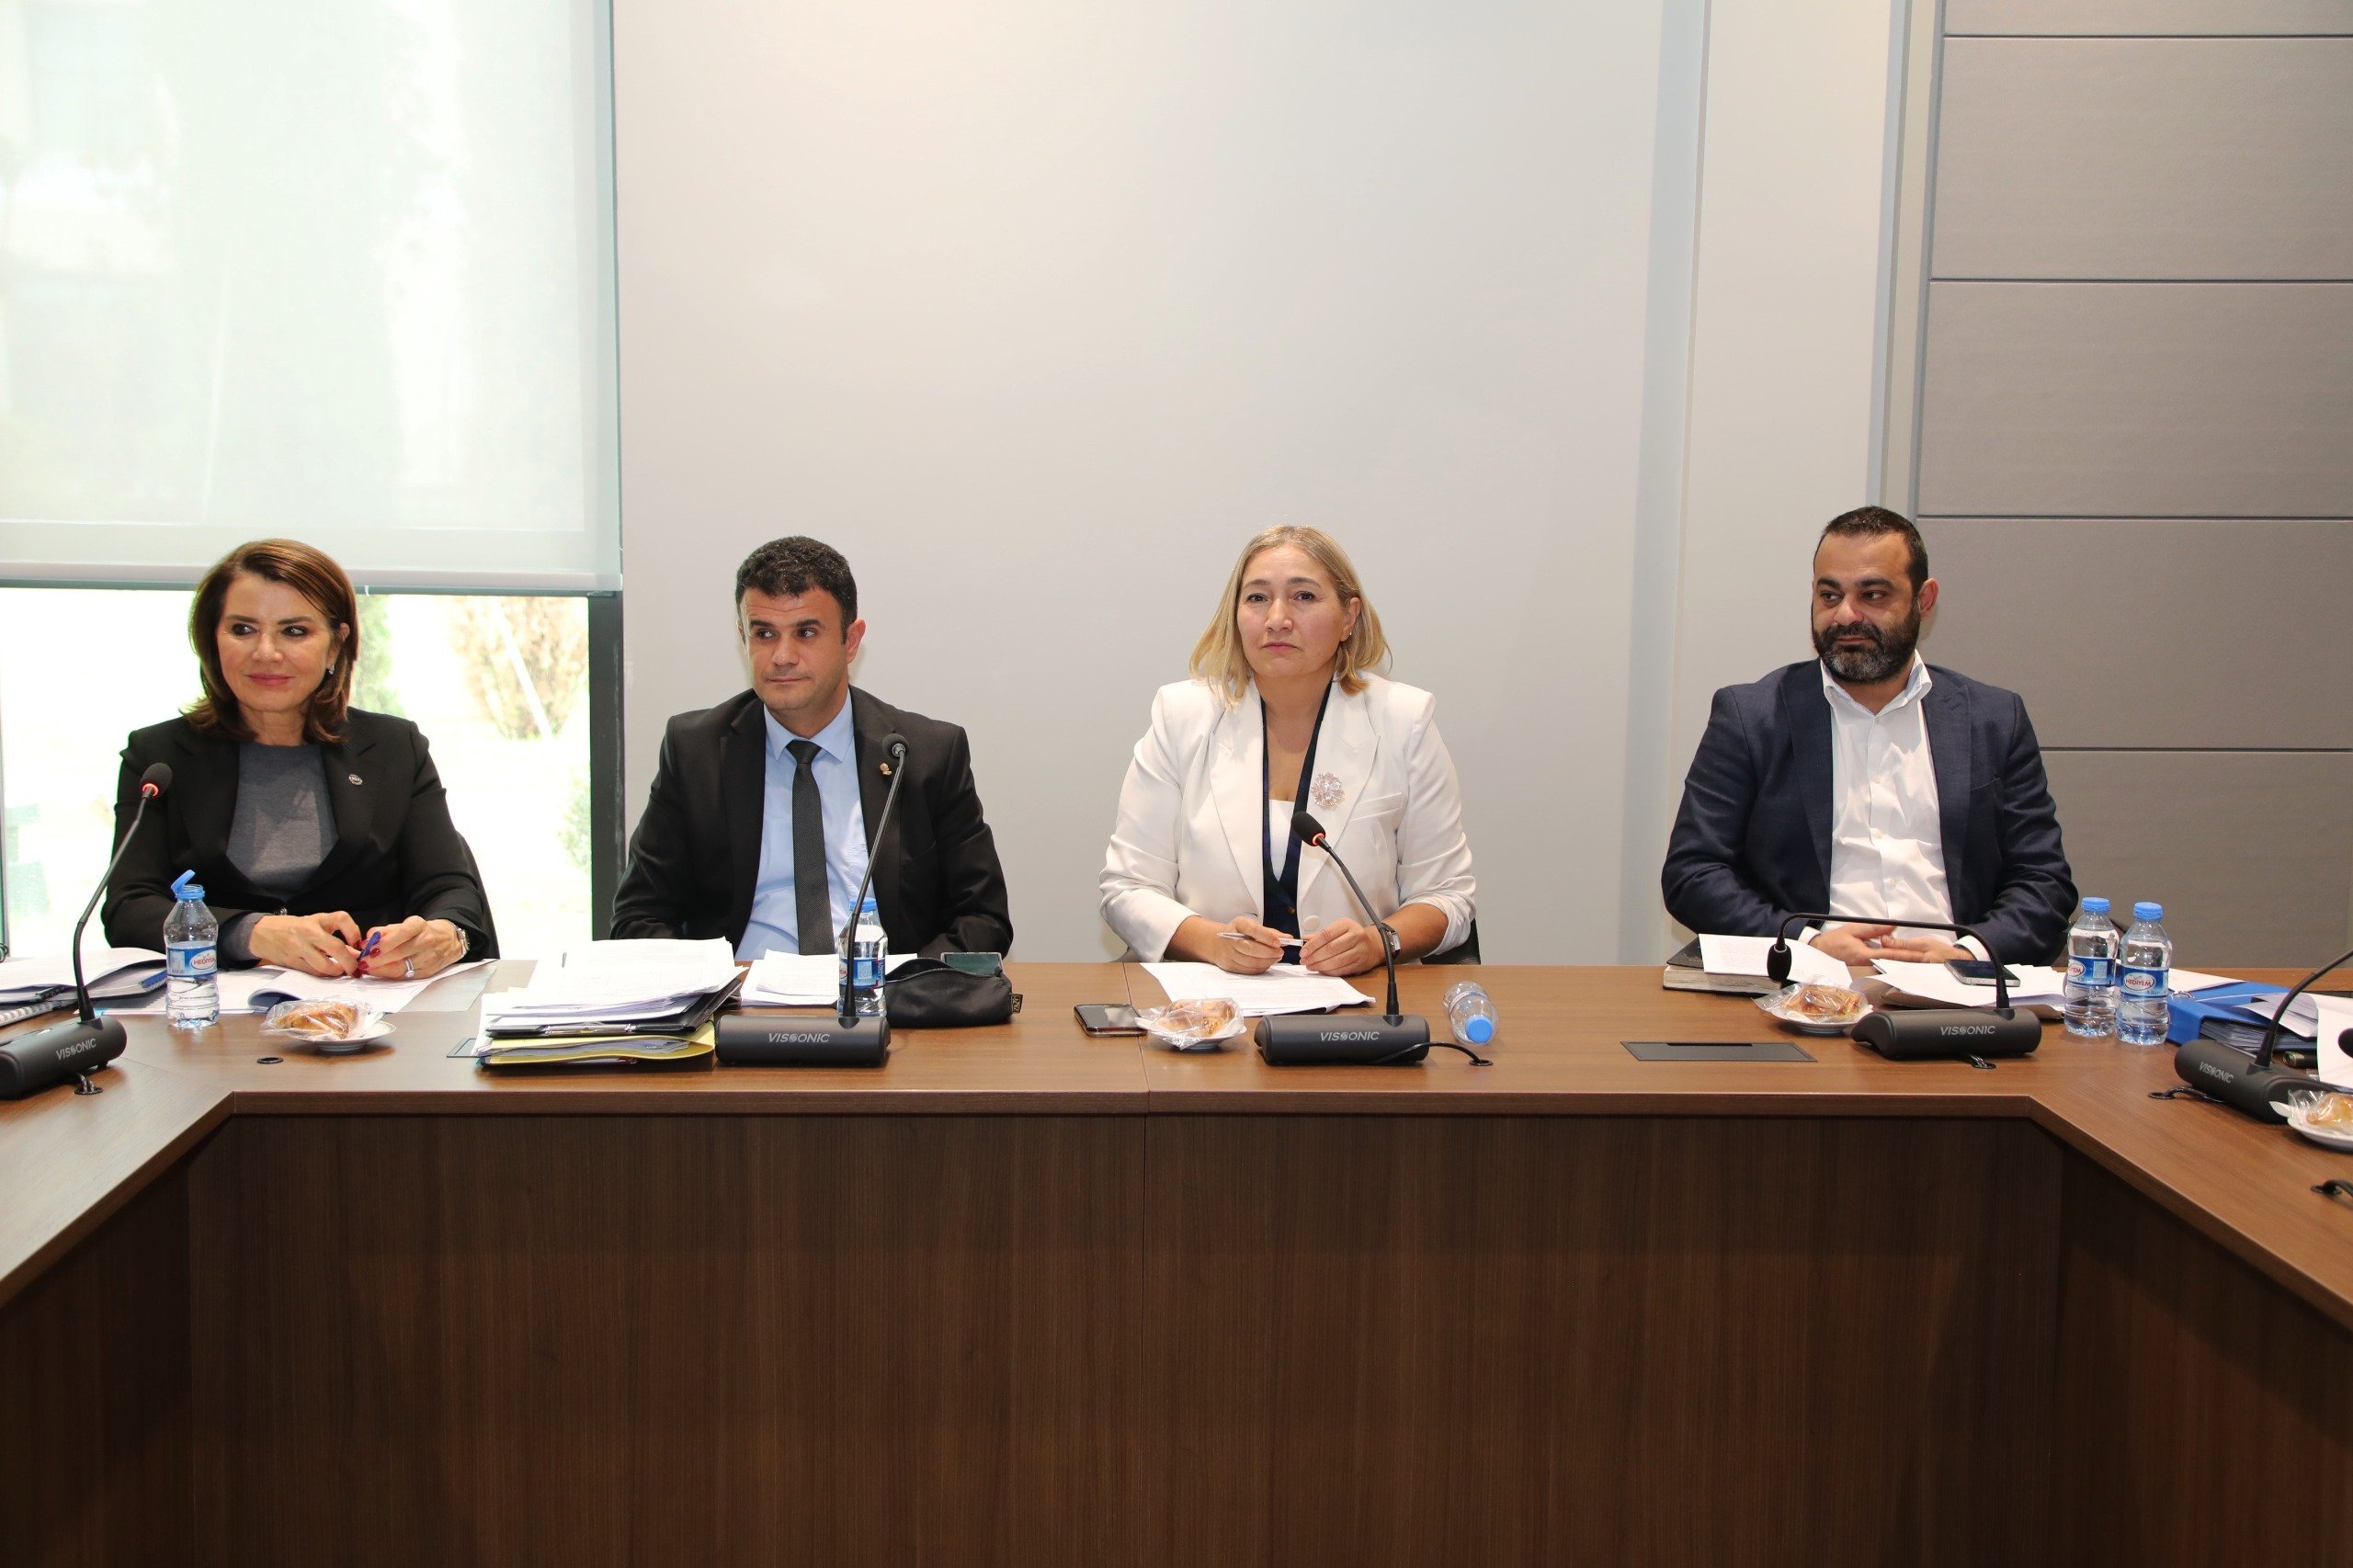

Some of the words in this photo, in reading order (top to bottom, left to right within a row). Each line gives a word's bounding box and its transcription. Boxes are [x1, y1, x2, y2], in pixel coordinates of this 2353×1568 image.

[1939, 1025, 1996, 1036] VISSONIC
[768, 1033, 831, 1043] VISSONIC
[1320, 1031, 1380, 1041] VISSONIC
[56, 1038, 97, 1061] VISSONIC
